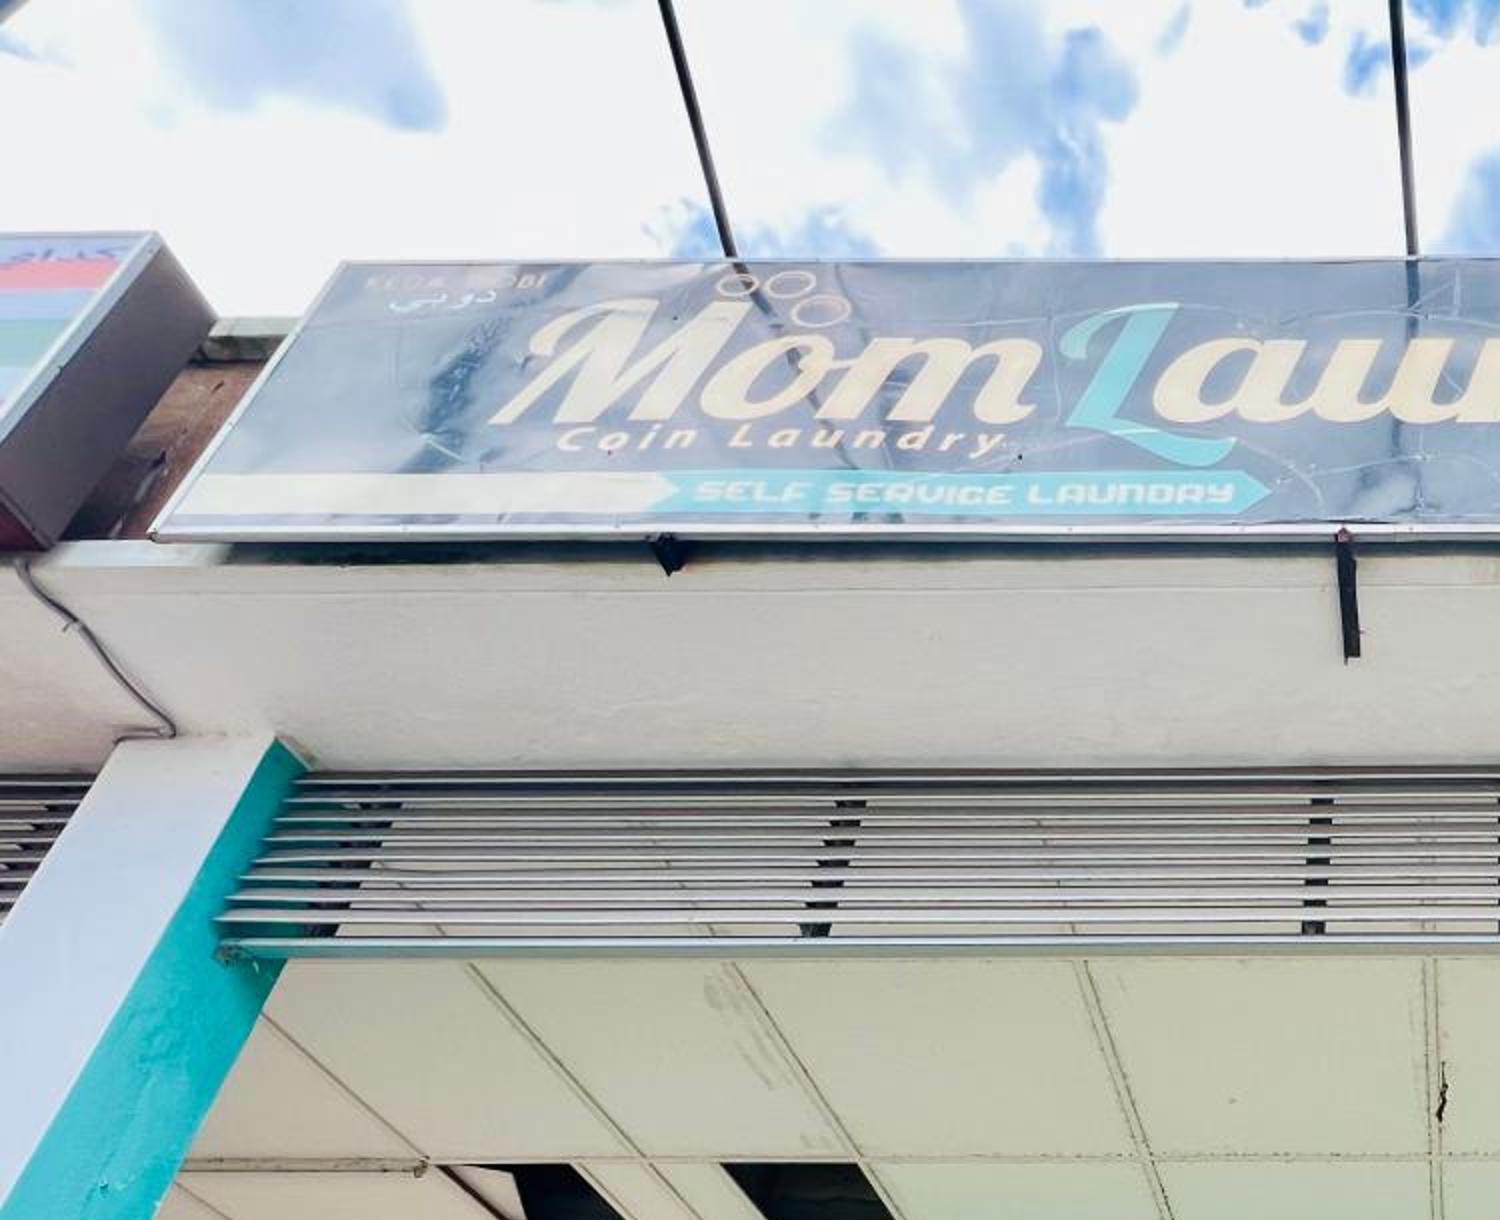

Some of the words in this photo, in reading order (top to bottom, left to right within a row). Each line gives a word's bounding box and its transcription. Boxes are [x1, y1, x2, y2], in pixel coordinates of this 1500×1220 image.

[488, 297, 1045, 427] Mom
[556, 423, 697, 451] Coin
[727, 423, 1007, 460] Laundry
[693, 480, 812, 503] SELF
[826, 481, 1014, 506] SERVICE
[1026, 481, 1236, 506] LAUNDRY
